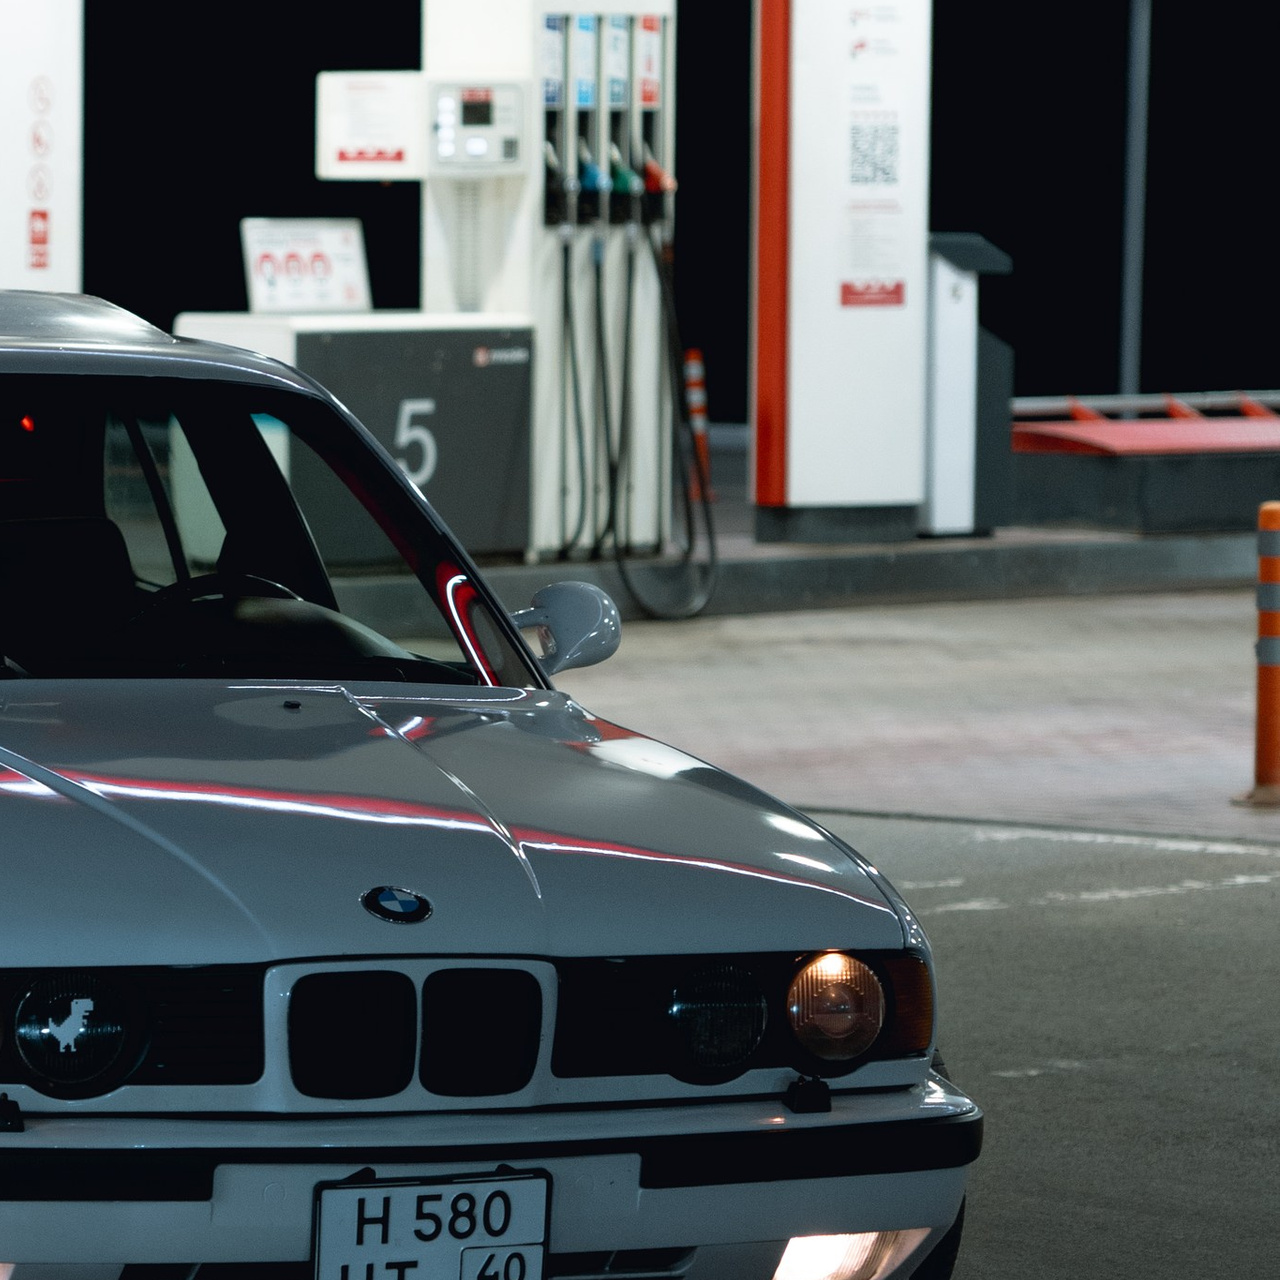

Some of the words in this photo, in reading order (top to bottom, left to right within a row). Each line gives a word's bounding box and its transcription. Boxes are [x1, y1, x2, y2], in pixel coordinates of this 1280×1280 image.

[394, 397, 438, 487] 5
[355, 1196, 391, 1246] H
[413, 1189, 512, 1242] 580
